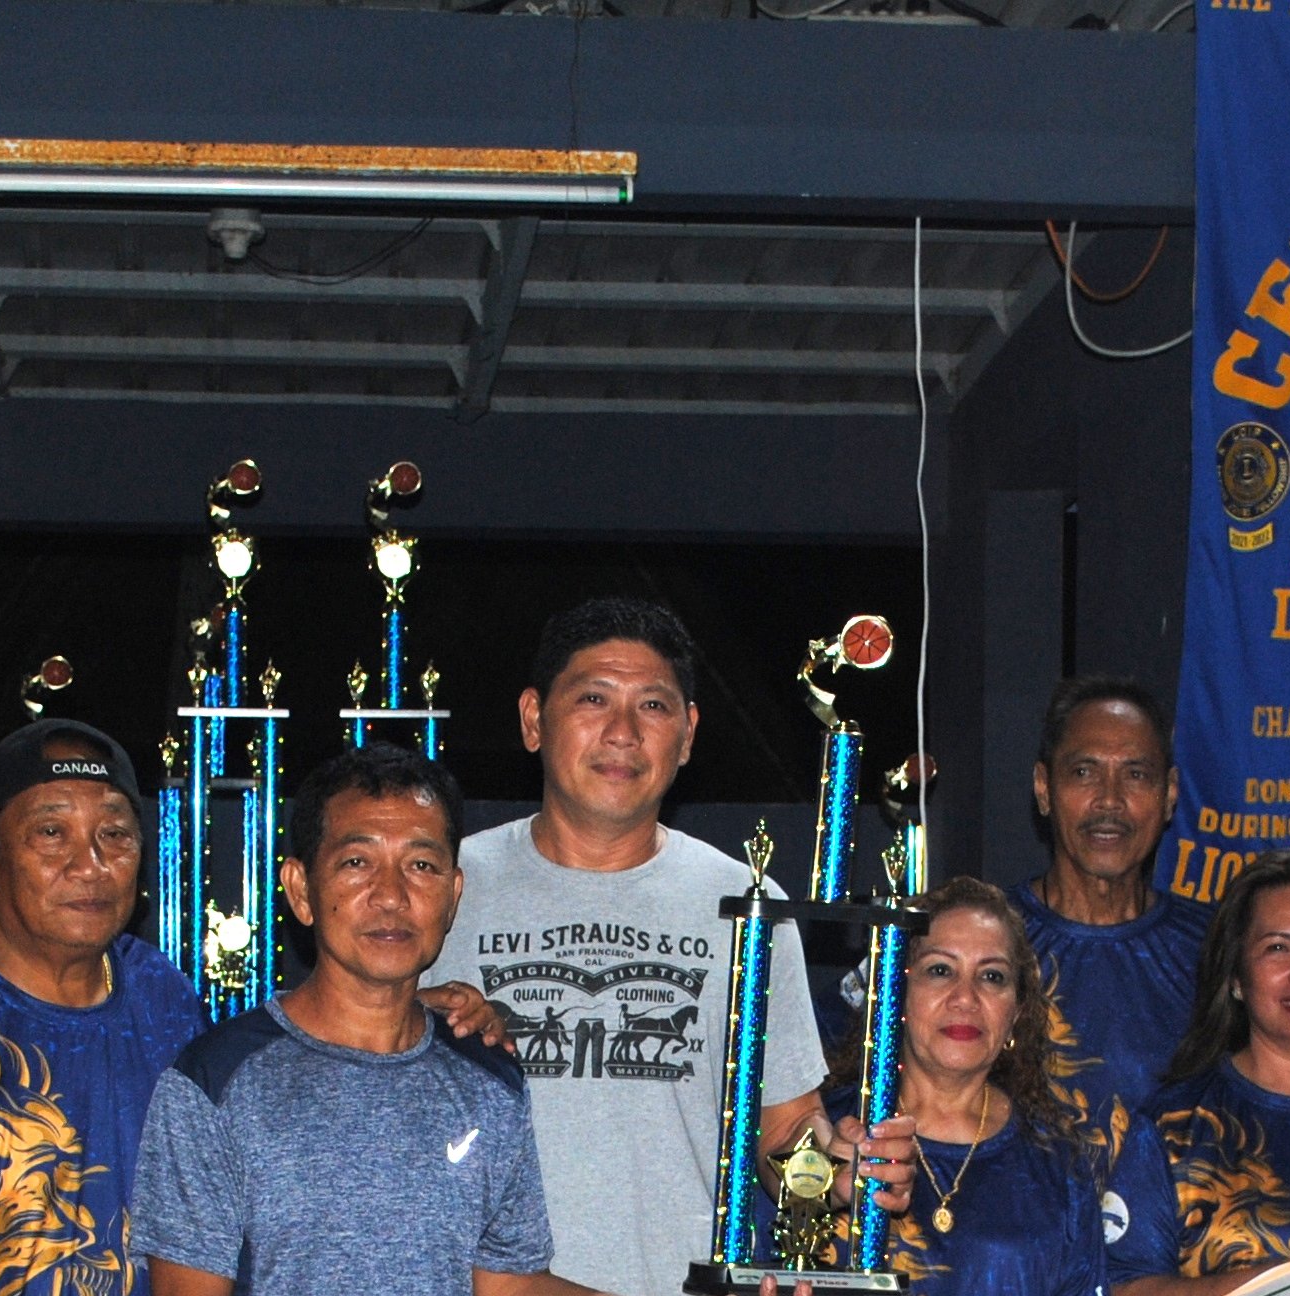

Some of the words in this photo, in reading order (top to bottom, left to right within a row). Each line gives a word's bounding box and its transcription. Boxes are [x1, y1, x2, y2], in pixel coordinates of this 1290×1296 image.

[51, 763, 109, 776] CANADA
[1170, 838, 1257, 903] LIO
[478, 932, 531, 955] LEVI
[540, 922, 651, 952] STRAUSS
[656, 934, 674, 955] &
[678, 936, 715, 960] CO.
[555, 950, 576, 960] SAN
[578, 948, 635, 960] FRANCISCO
[584, 957, 607, 967] CAL.
[490, 965, 587, 987] ORIGINAL
[603, 966, 696, 989] RIVETED
[512, 988, 565, 1004] QUALITY
[615, 988, 675, 1004] CLOTHING
[687, 1038, 705, 1055] XX
[615, 1067, 640, 1077] MAY
